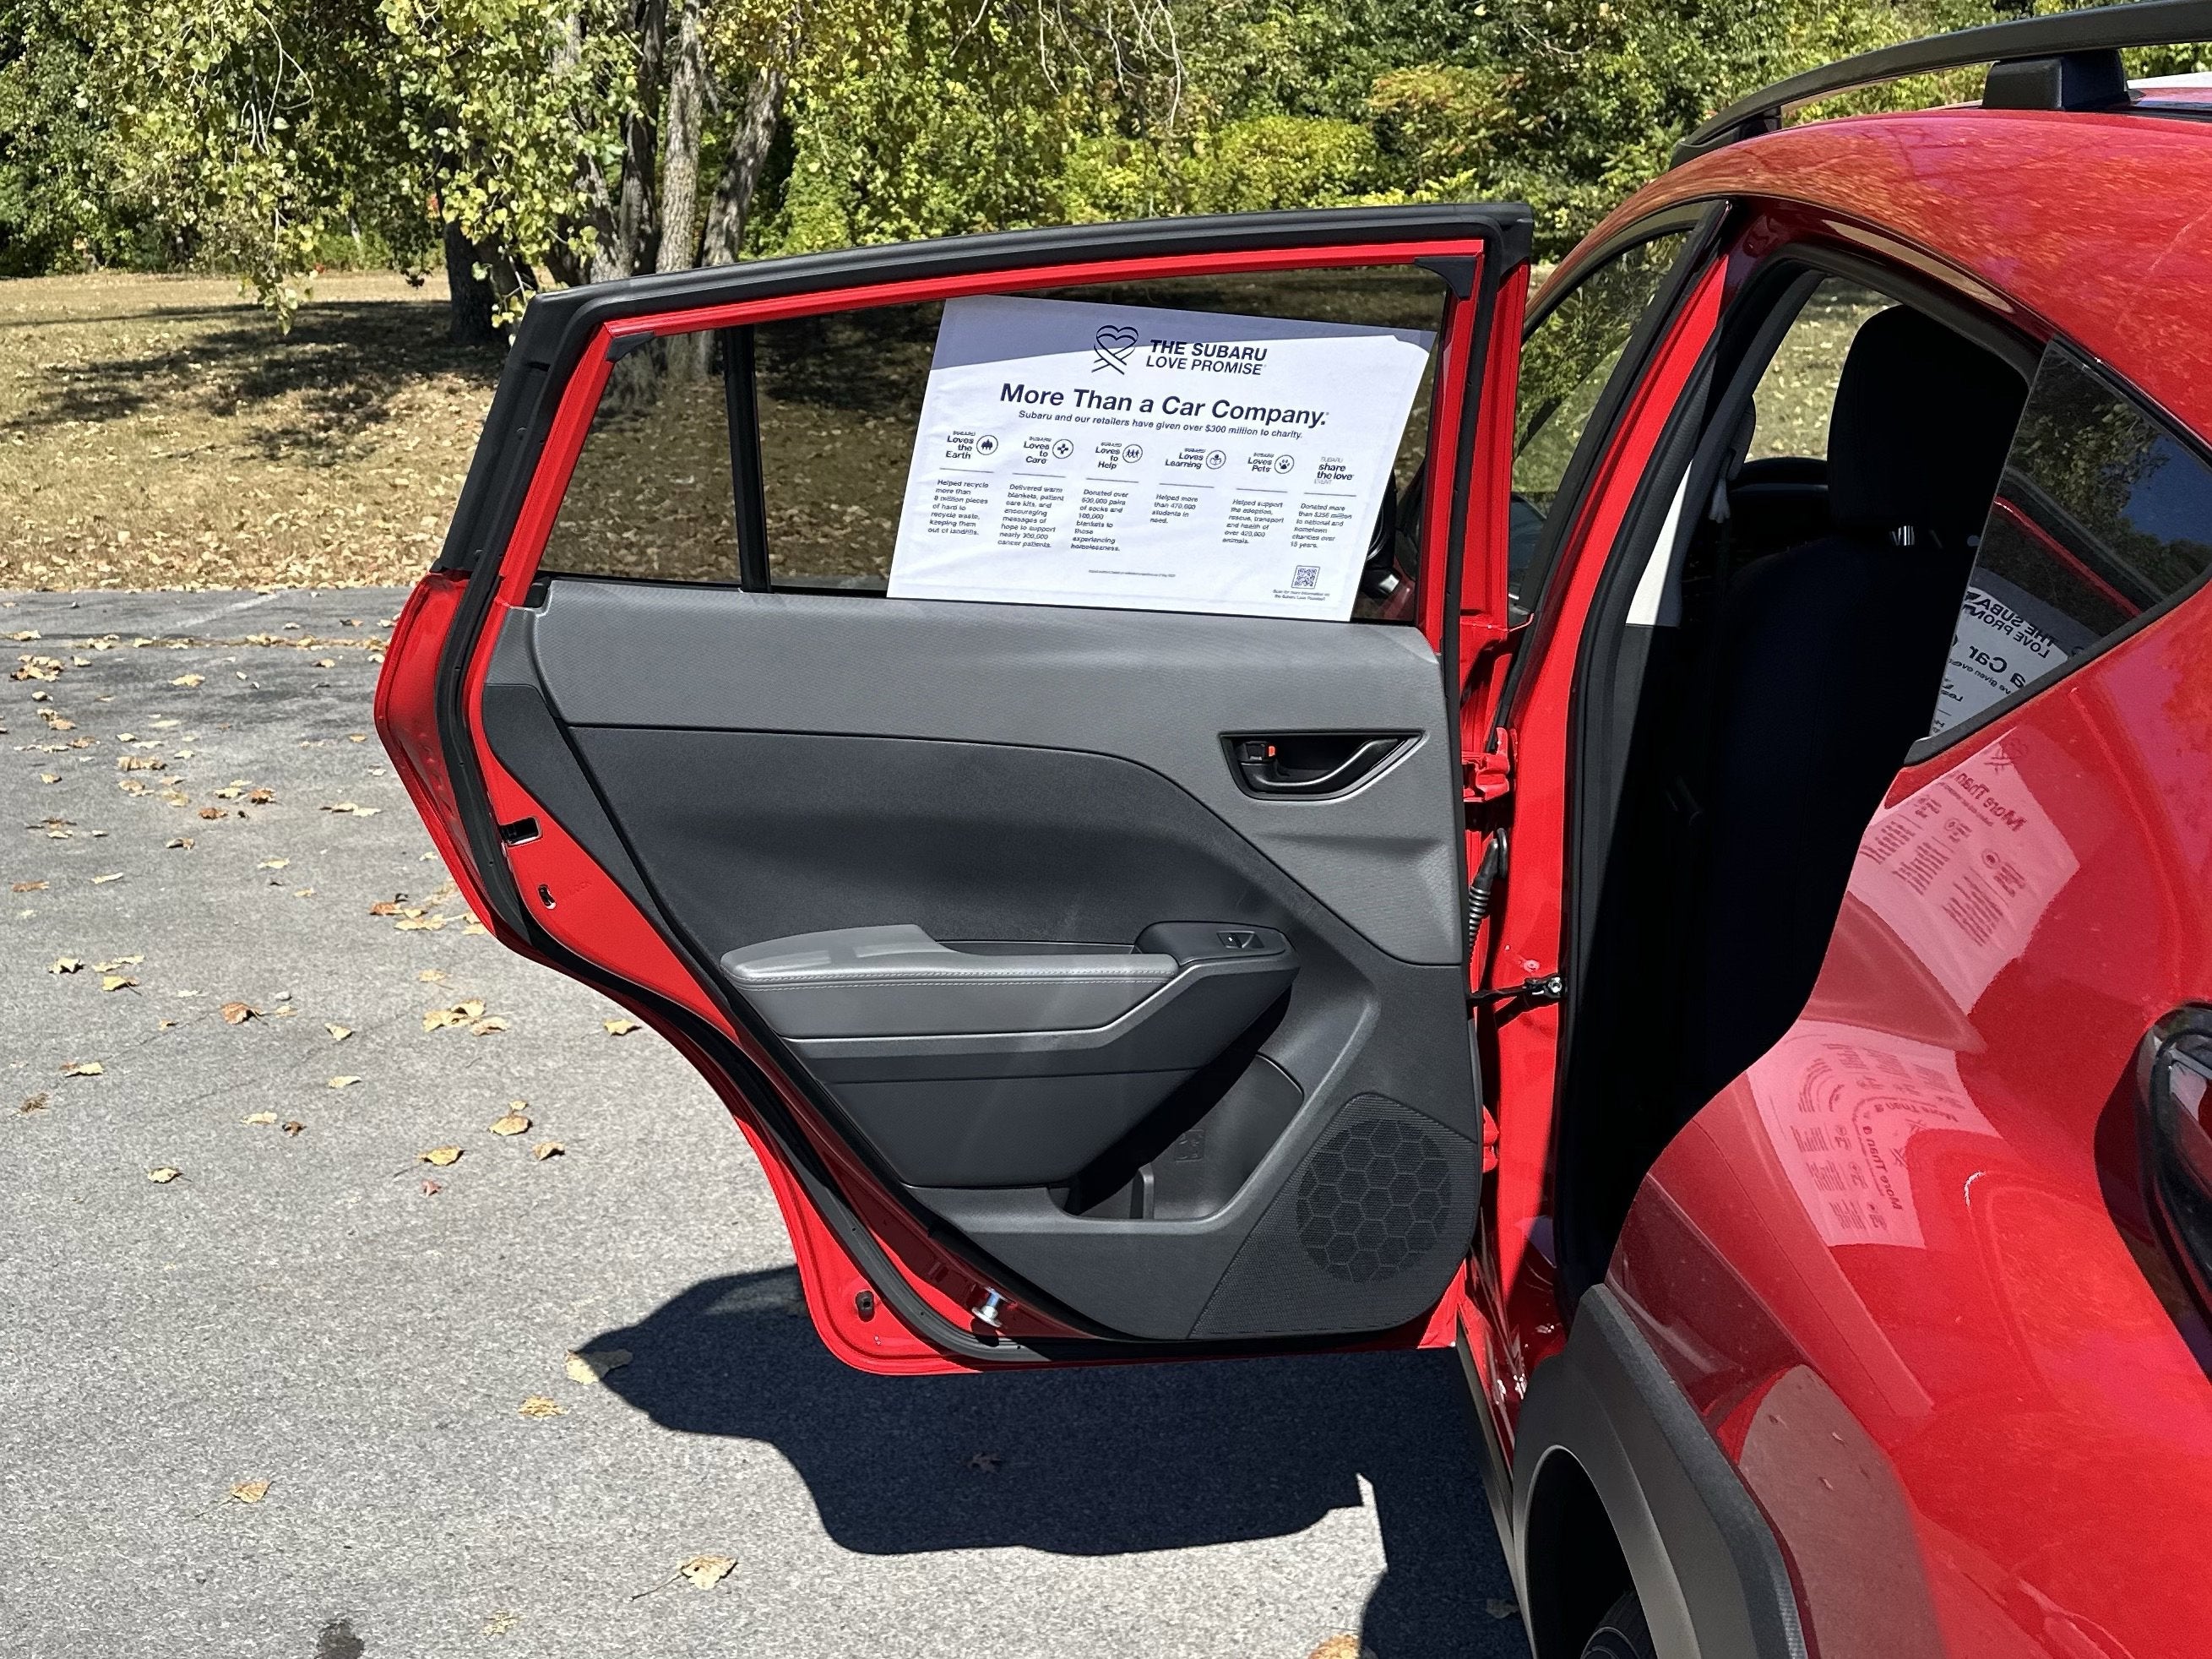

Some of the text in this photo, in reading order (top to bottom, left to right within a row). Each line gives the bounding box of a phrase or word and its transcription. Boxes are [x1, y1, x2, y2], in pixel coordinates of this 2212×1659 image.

[1150, 340, 1268, 362] THE SUBARU
[1146, 356, 1264, 375] LOVE PROMISE
[1000, 383, 1326, 428] More Than a Car Company.
[1019, 410, 1052, 421] Subaru
[1055, 414, 1073, 422] and
[1092, 417, 1130, 427] retailers
[1132, 419, 1154, 428] have
[1155, 422, 1181, 430] given
[1205, 424, 1226, 433] $300
[1228, 426, 1258, 436] million
[1271, 429, 1302, 440] charity.
[1024, 441, 1050, 449] Loves
[1095, 446, 1120, 454] Loves
[946, 451, 971, 460] Earth
[1179, 452, 1204, 460] Loves
[1098, 461, 1117, 470] Help
[1165, 459, 1203, 470] Learning
[1247, 457, 1273, 465] Loves
[1318, 463, 1346, 471] share
[1318, 471, 1352, 481] the love
[1009, 483, 1042, 492] Delivered
[1008, 492, 1038, 501] blankets,
[1004, 509, 1047, 517] encouraging
[1003, 516, 1037, 525] messages
